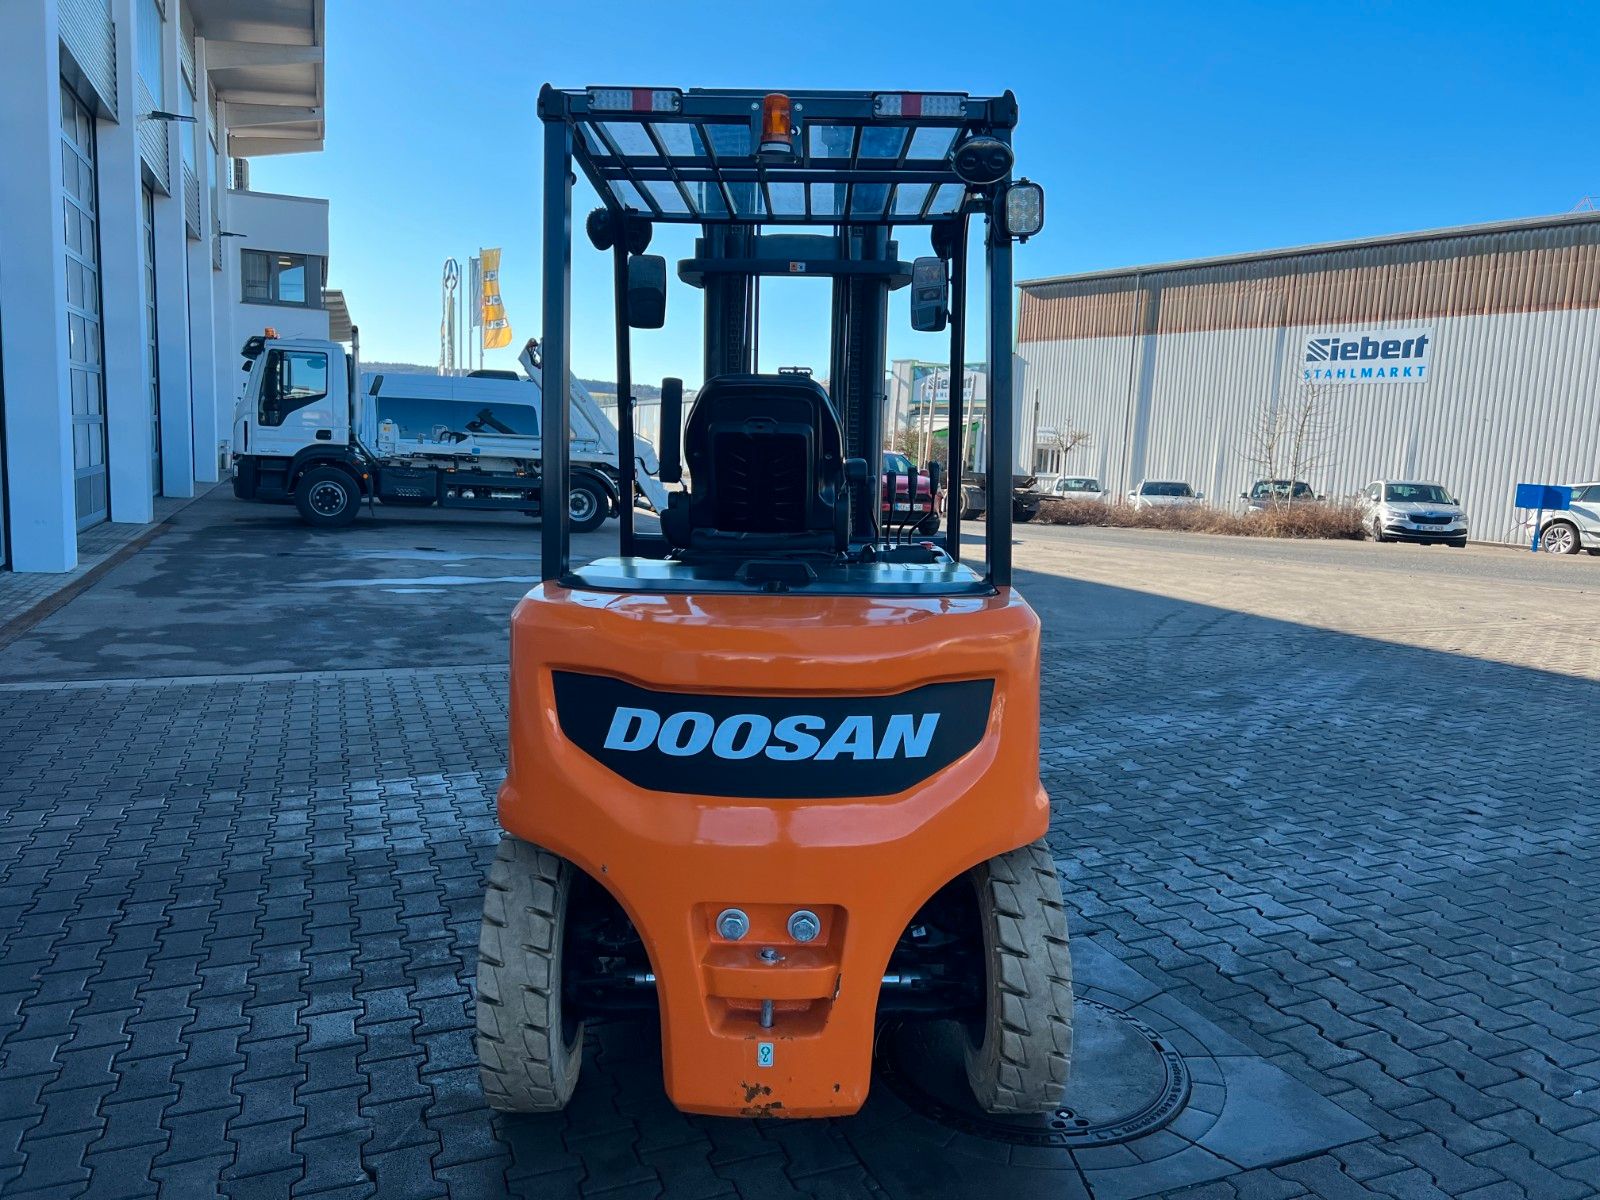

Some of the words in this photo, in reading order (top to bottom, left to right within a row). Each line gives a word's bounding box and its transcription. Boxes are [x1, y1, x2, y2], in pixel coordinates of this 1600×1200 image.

[1306, 334, 1429, 362] Siebert
[1303, 366, 1426, 380] STAHLMARKT
[603, 706, 941, 761] DOOSAN
